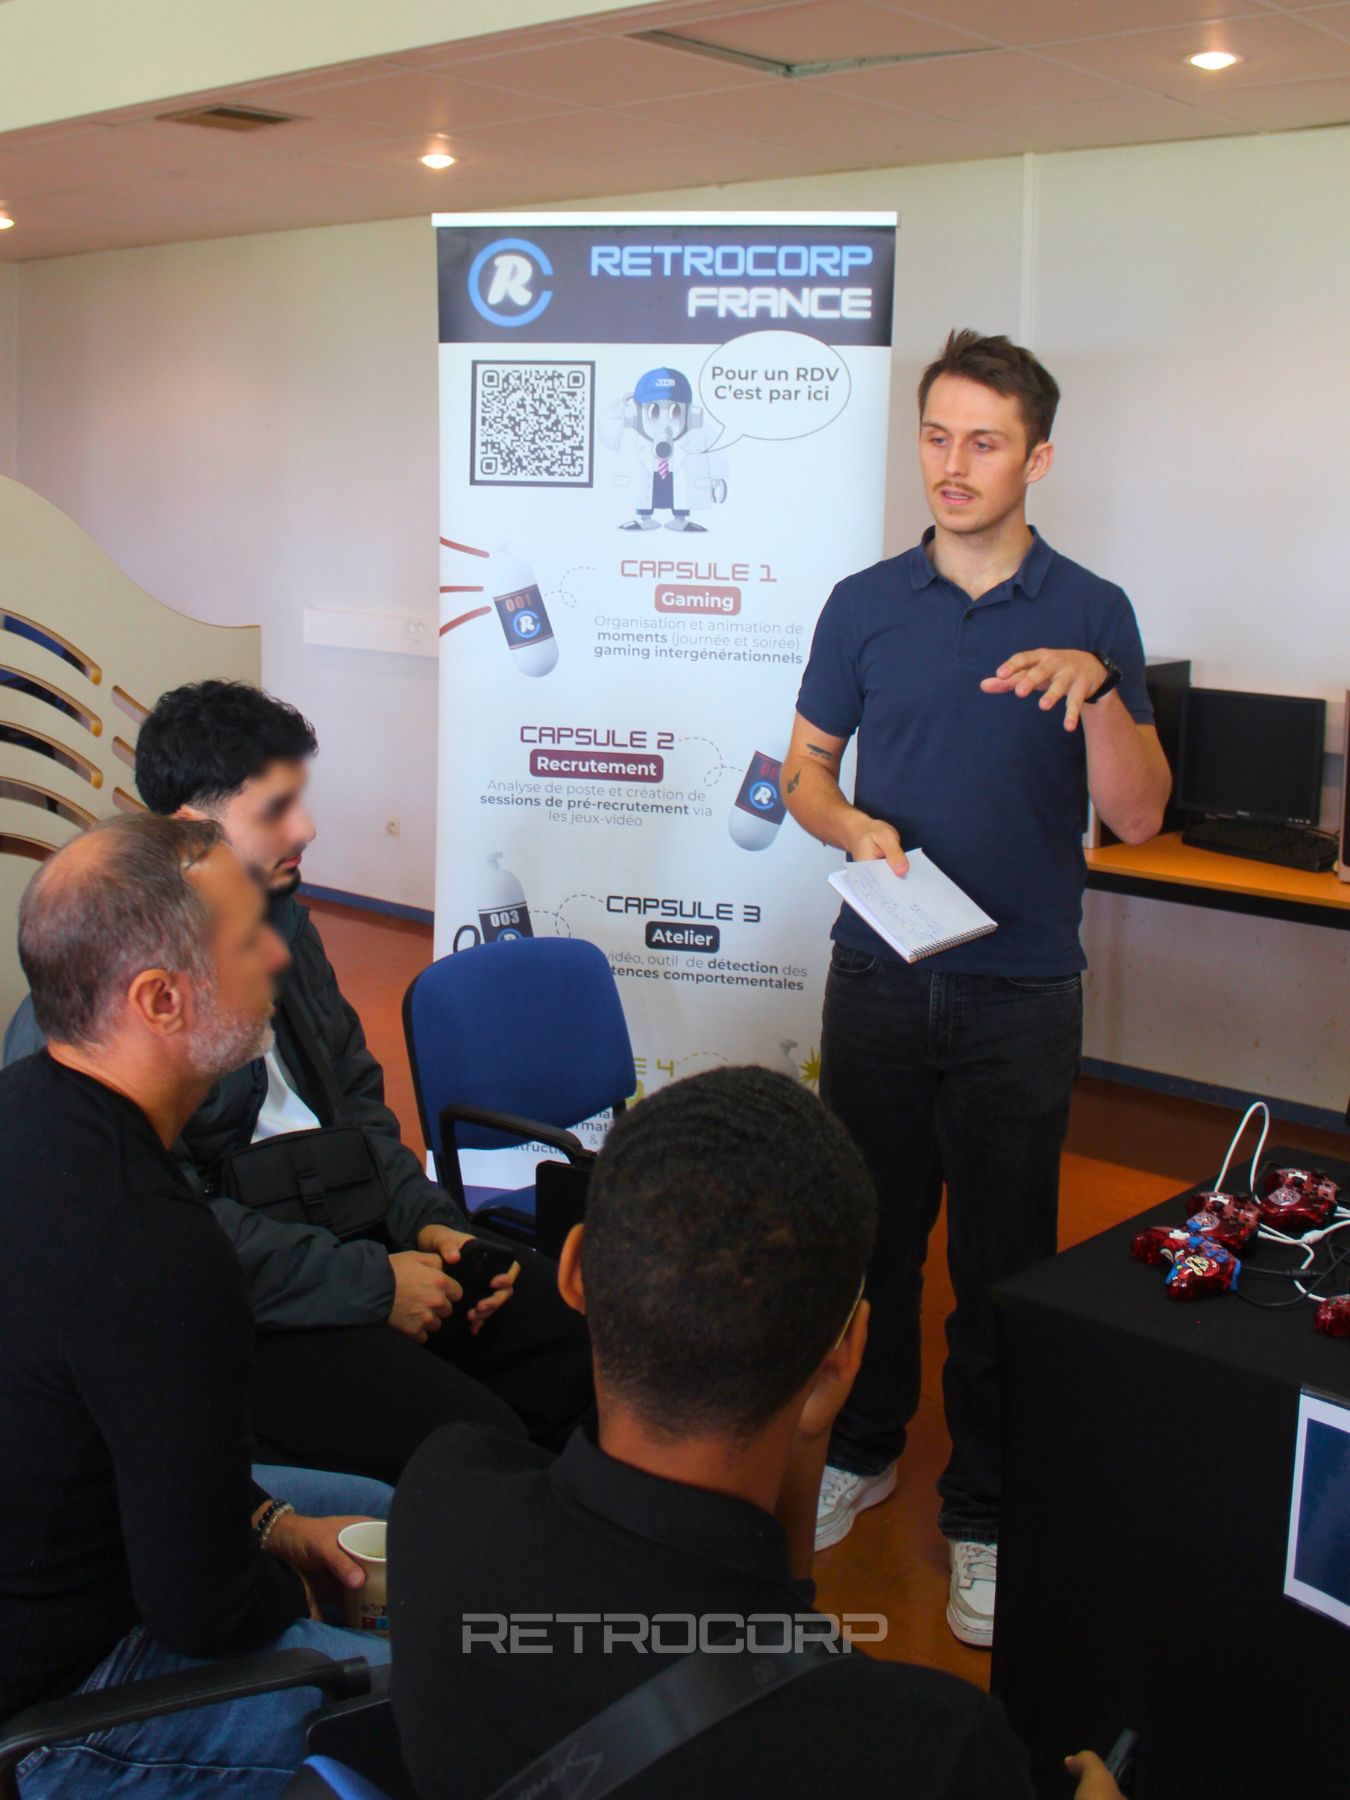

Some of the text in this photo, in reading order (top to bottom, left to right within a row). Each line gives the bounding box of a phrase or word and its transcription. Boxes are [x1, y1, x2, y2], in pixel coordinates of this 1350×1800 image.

[590, 245, 873, 277] RETROCORP
[687, 287, 873, 319] FRANCE
[711, 366, 840, 382] Pour un RDV
[769, 388, 802, 404] par
[807, 386, 830, 401] ici
[620, 559, 777, 583] CAPSULE 1
[661, 591, 735, 612] Gaming
[594, 615, 805, 635] Organisation et animation de
[596, 631, 801, 650] moments (journée et soirée)
[593, 645, 803, 665] gaming intergénérationnels
[519, 725, 675, 750] CAPSULE 2
[536, 756, 657, 777] Recrutement
[486, 779, 706, 802] Analyse de poste et création de
[479, 794, 713, 817] sessions de pré-recrutement via
[548, 809, 644, 827] les jeux-vidéo
[489, 909, 520, 928] 003
[606, 895, 762, 923] CAPSULE 3
[651, 928, 714, 947] Atelier
[647, 952, 679, 968] outil
[685, 956, 705, 969] de
[707, 957, 779, 975] détection
[782, 964, 809, 978] des
[611, 965, 804, 991] tences comportementales
[656, 1058, 675, 1078] 4
